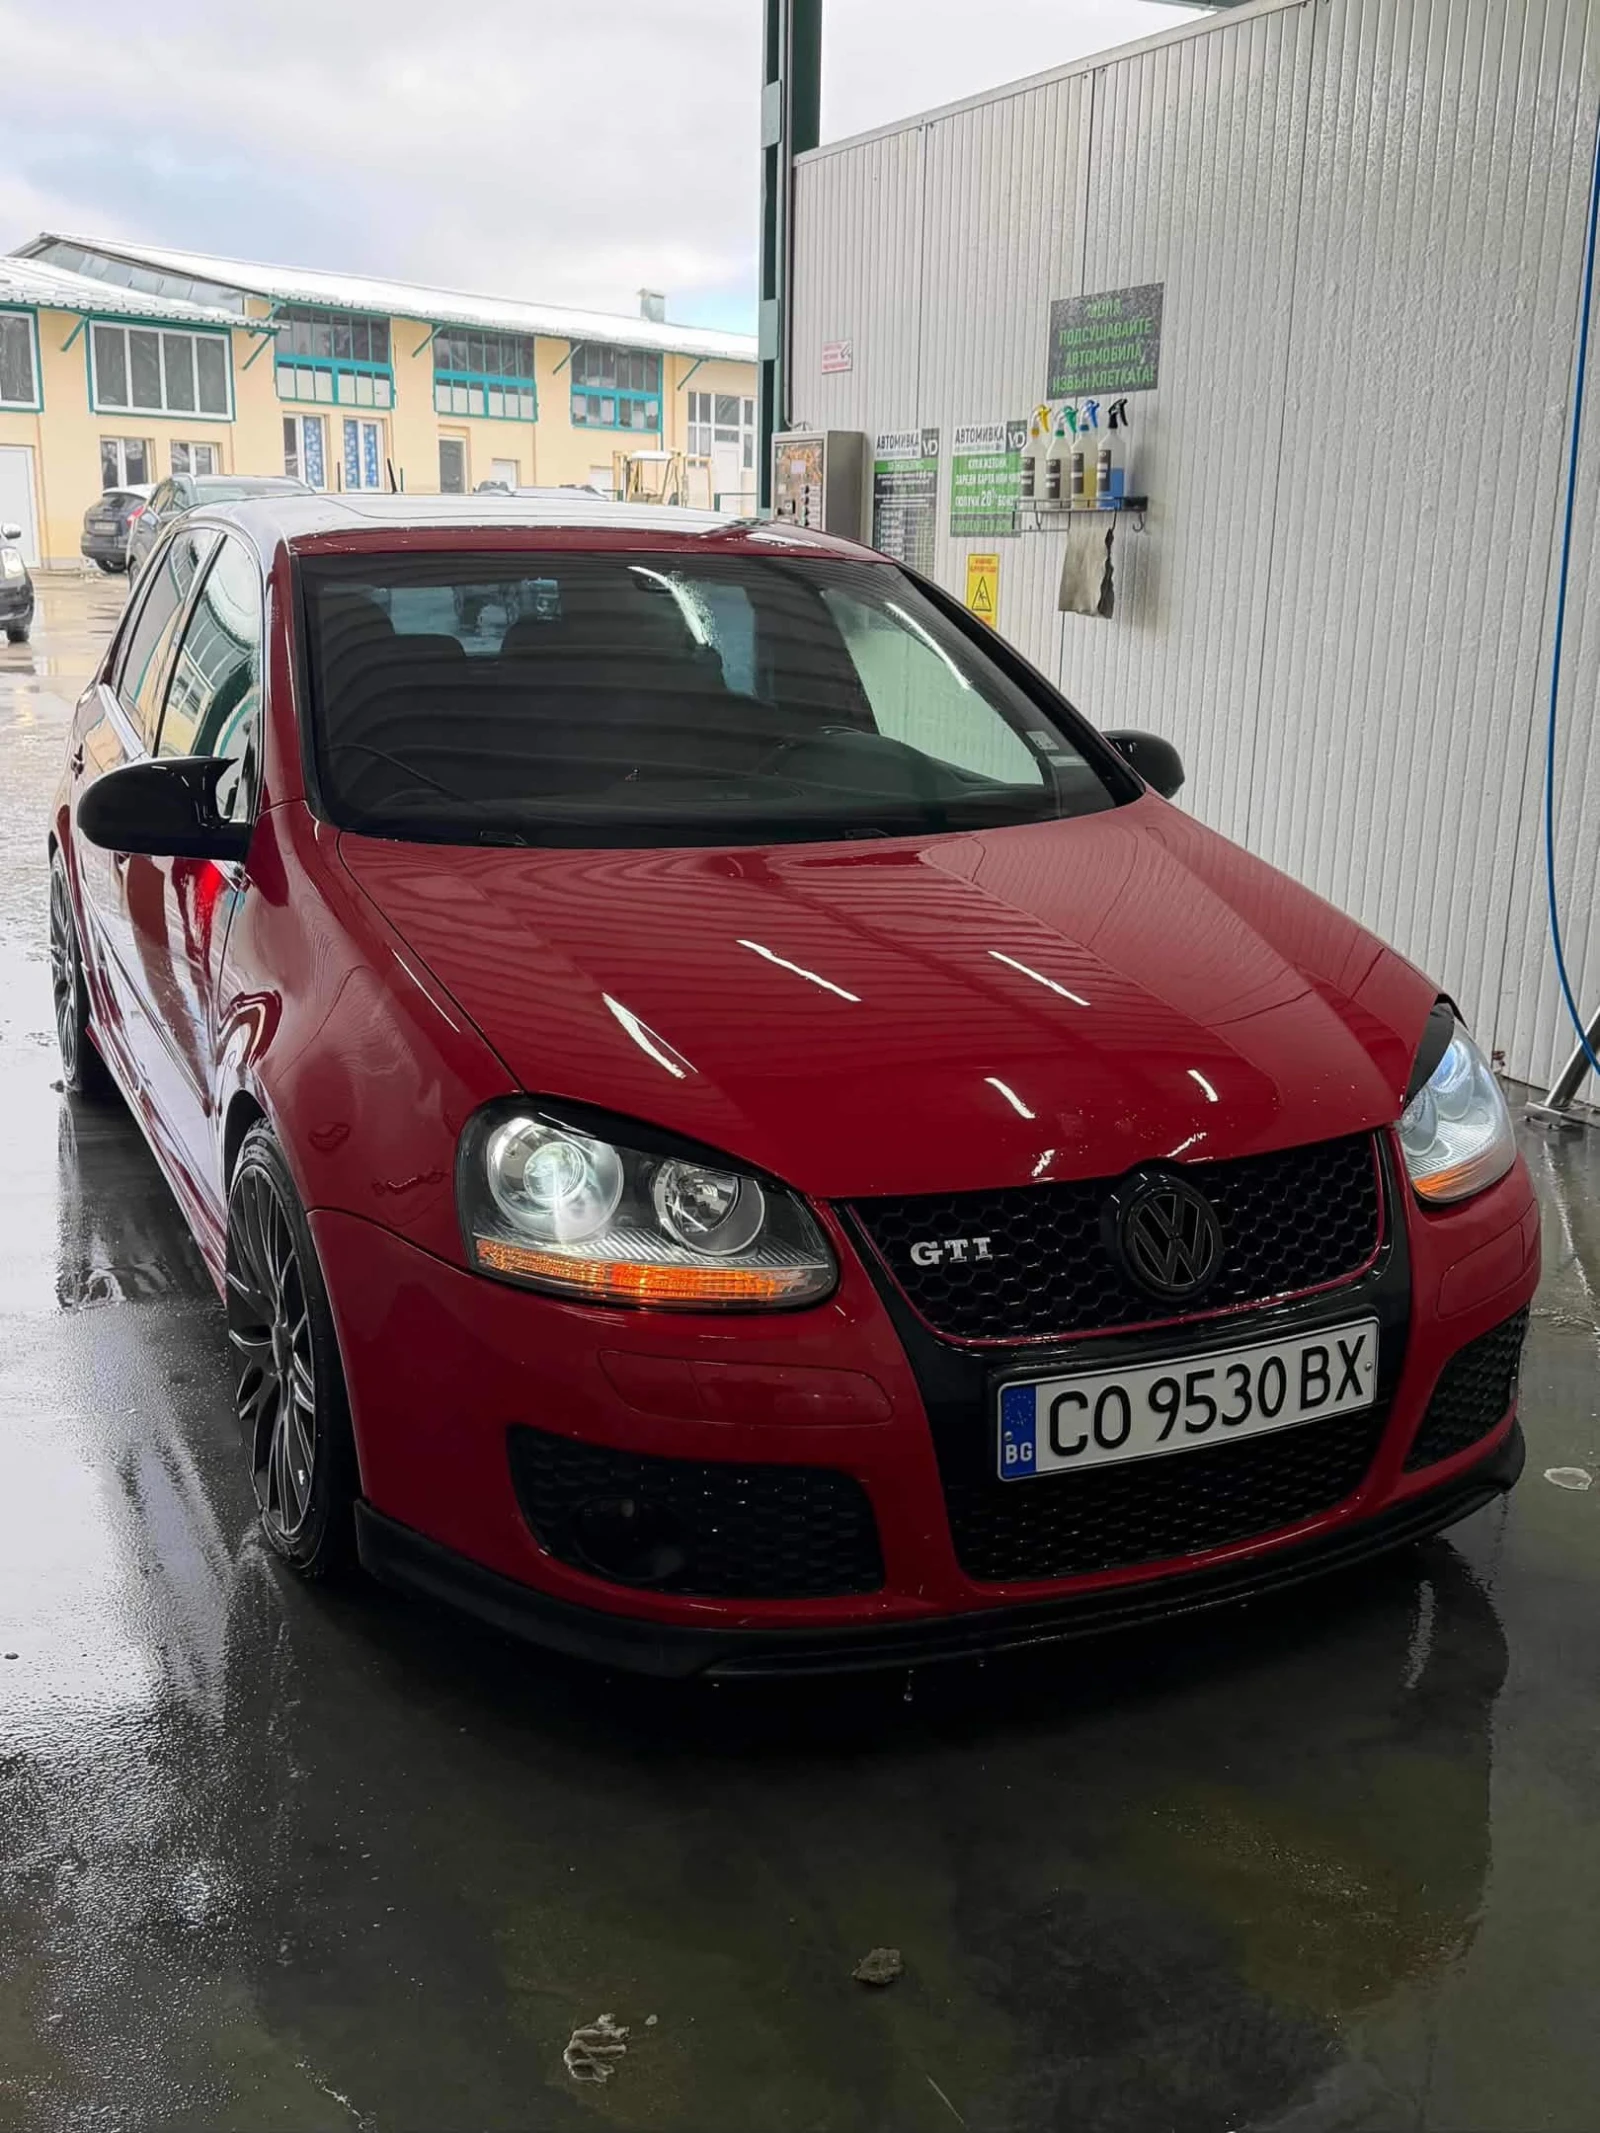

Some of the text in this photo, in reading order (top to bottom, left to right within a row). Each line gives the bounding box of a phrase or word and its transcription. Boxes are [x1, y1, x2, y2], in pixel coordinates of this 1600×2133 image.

[1059, 316, 1153, 346] ПОДСУШАВАЙТЕ
[1065, 343, 1142, 369] АВТОМОБИЛА
[1053, 372, 1089, 393] ИЗВЪН
[876, 432, 919, 450] АВТОМИВКА
[956, 426, 1004, 443] АВТОМИВКА
[910, 1236, 993, 1266] GTI
[1050, 1334, 1367, 1456] CO 9530 BX
[1005, 1442, 1033, 1465] BG
